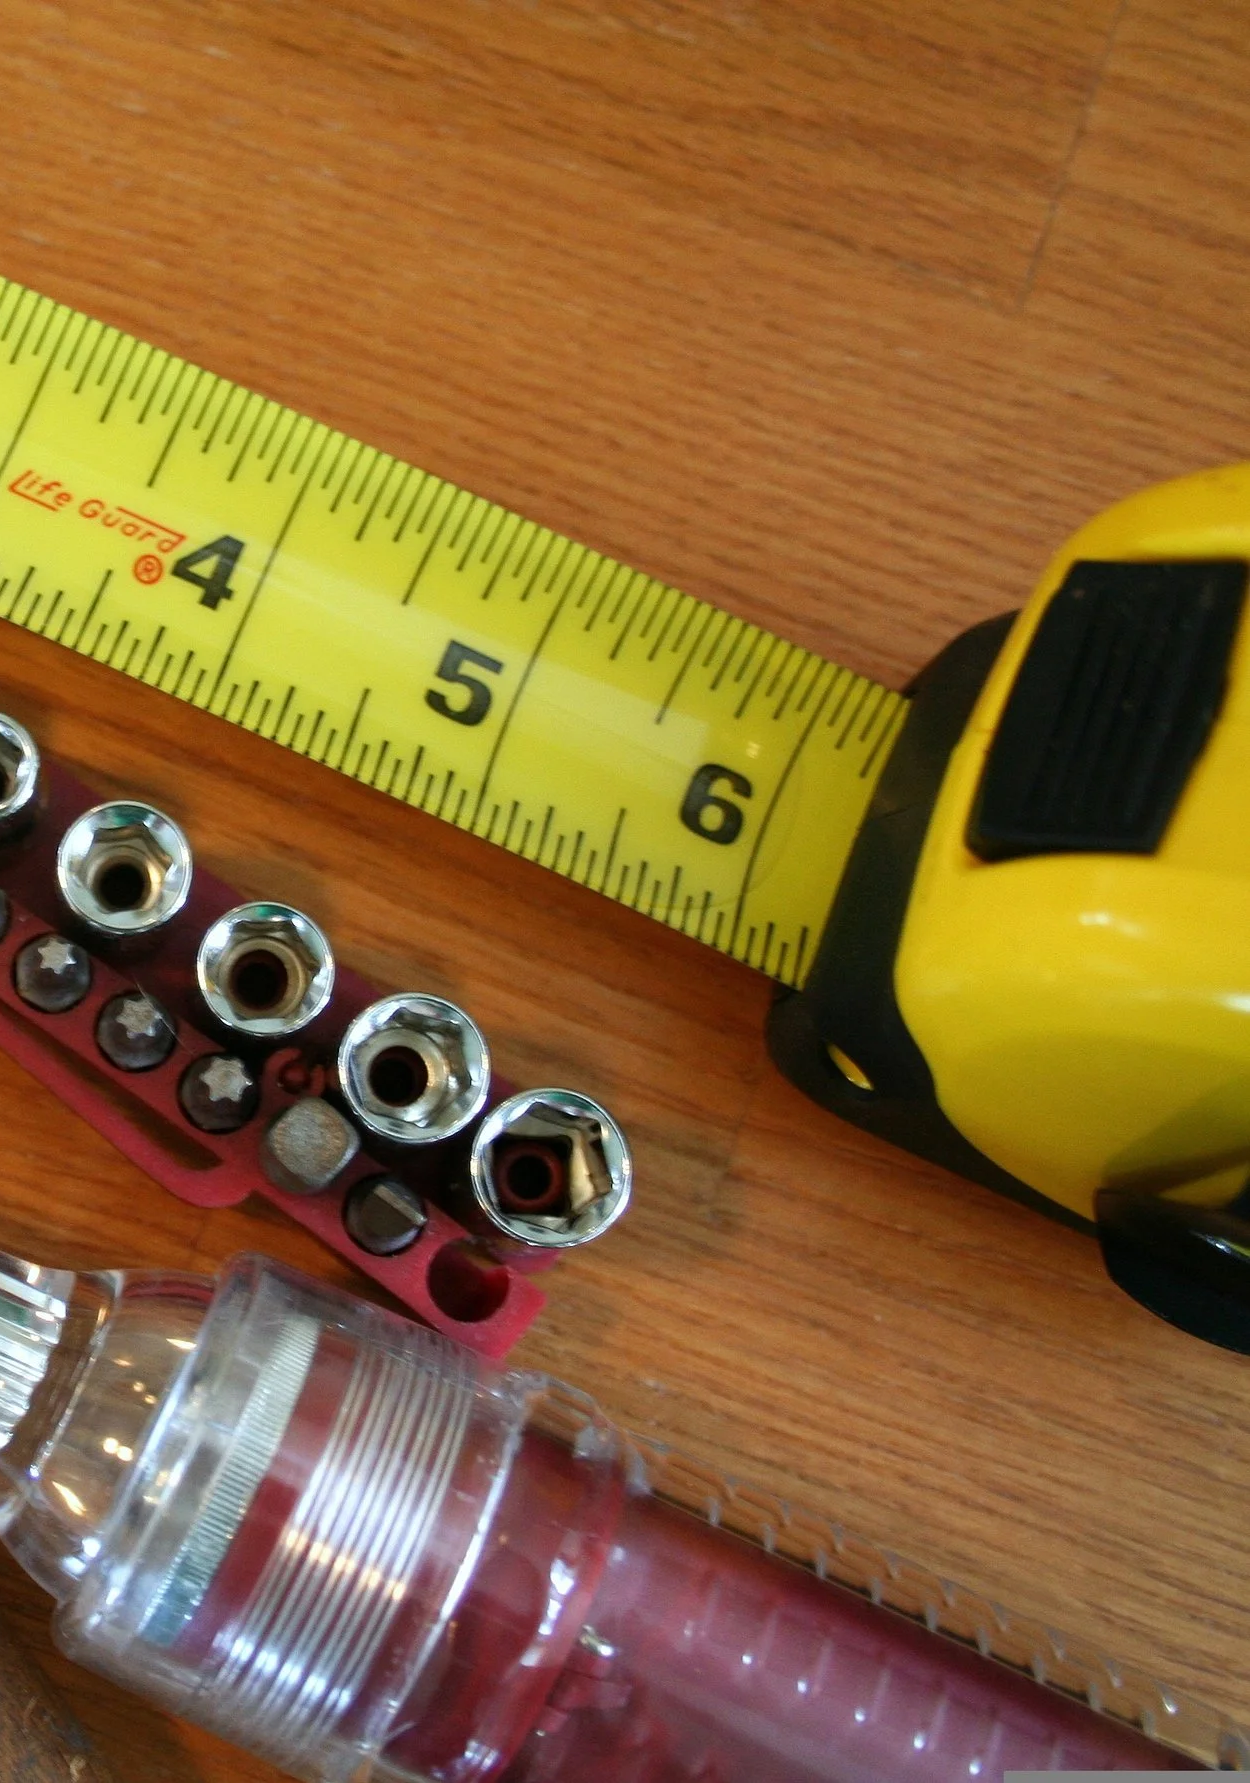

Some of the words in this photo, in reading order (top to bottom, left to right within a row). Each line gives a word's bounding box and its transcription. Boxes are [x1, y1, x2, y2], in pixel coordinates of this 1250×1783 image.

[8, 469, 73, 513] Life
[78, 498, 188, 554] Guard
[171, 534, 246, 612] 4
[424, 639, 505, 727] 5
[679, 763, 754, 846] 6
